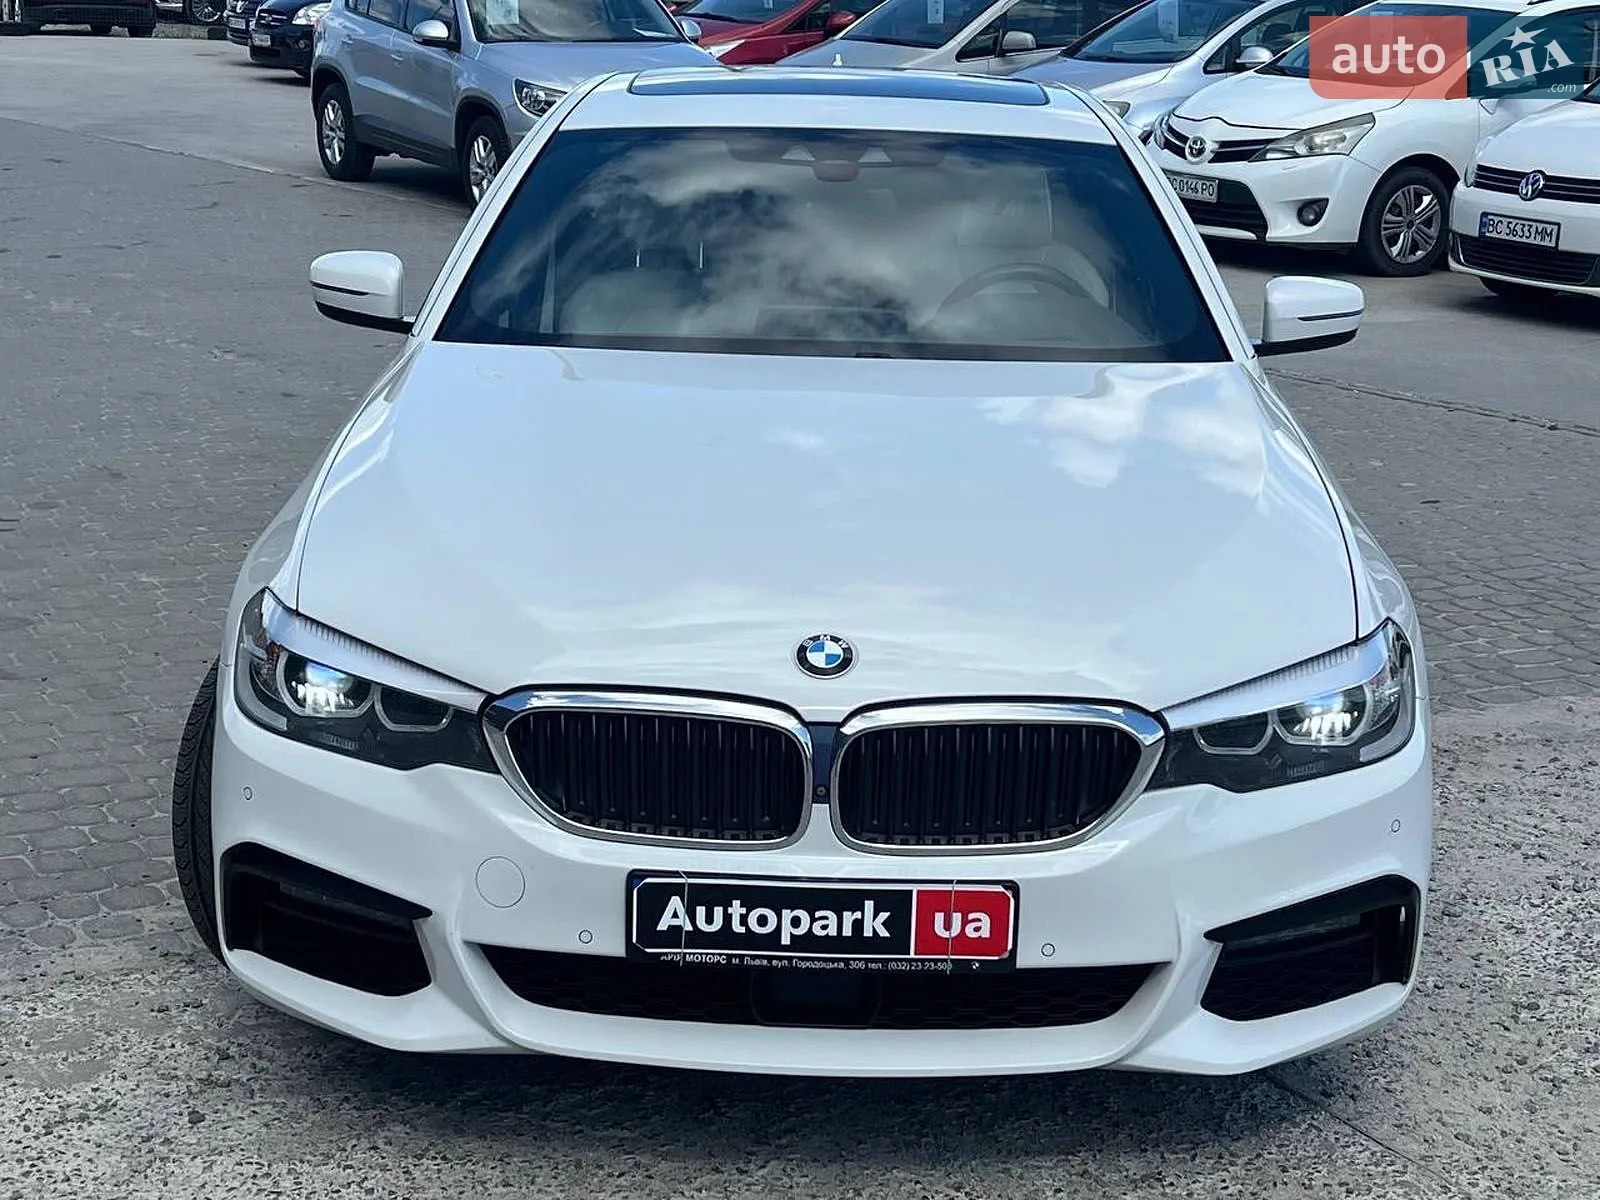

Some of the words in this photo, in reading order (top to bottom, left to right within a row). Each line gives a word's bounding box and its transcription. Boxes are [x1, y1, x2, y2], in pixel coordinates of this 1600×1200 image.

[1201, 182, 1215, 197] PO
[1487, 219, 1503, 234] BC
[1506, 221, 1533, 240] 5633
[1534, 225, 1554, 243] MM
[656, 895, 891, 945] Autopark
[934, 911, 991, 938] ua
[686, 953, 727, 964] МОТОРС
